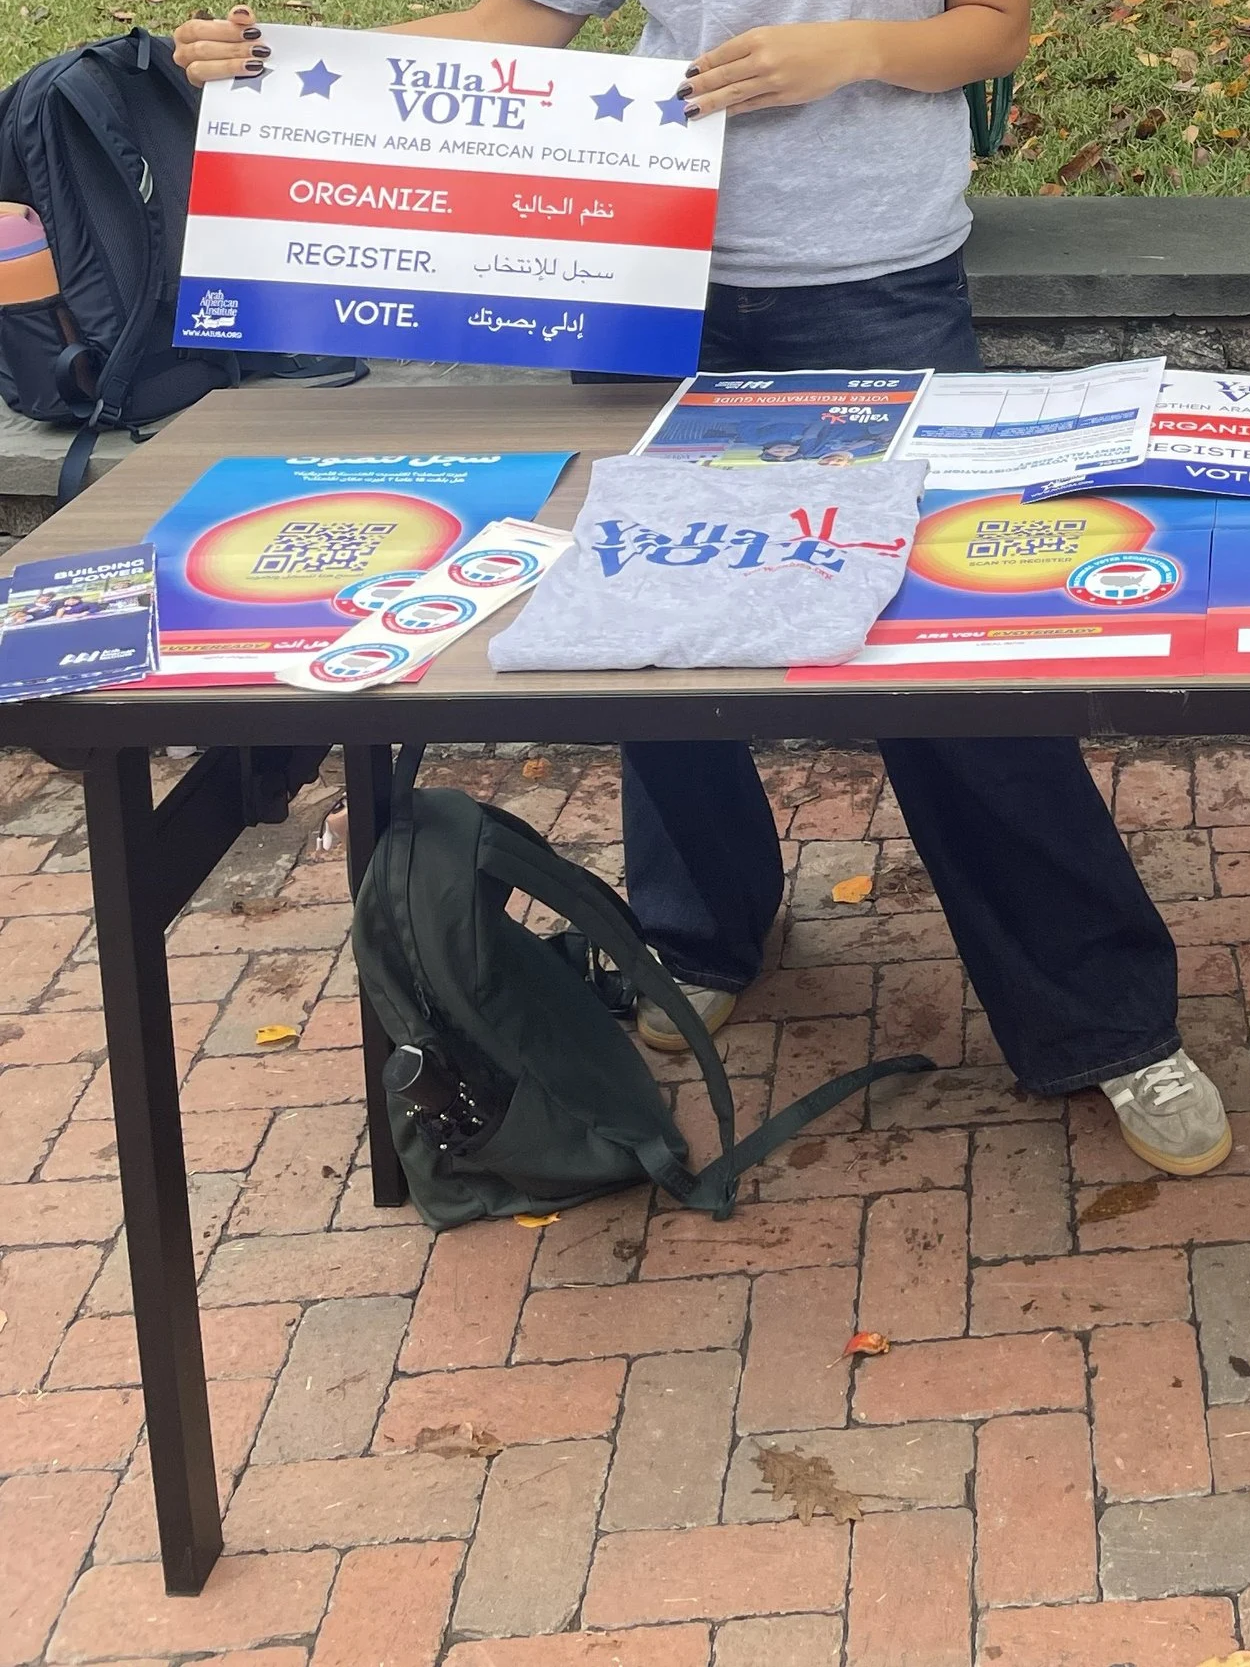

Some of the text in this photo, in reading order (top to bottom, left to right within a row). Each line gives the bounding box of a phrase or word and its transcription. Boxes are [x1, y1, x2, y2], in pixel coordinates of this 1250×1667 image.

[386, 57, 485, 93] Yalla
[389, 88, 527, 130] VOTE
[207, 121, 712, 173] HELP STRENGTHEN ARAB AMERICAN POLITICAL POWER
[289, 180, 453, 215] ORGANIZE.
[511, 193, 615, 226] نظم الجالية
[286, 241, 436, 274] REGISTER.
[562, 260, 615, 284] سجل
[200, 297, 239, 308] American
[205, 289, 225, 300] Arab
[205, 307, 238, 317] Institute
[334, 298, 419, 329] VOTE.
[467, 306, 537, 335] بصوتك
[847, 379, 900, 388] 2025
[712, 394, 890, 405] VOTER REGISTRATION GUIDE
[53, 558, 145, 580] BUILDING
[72, 567, 145, 584] POWER
[916, 630, 949, 640] ARE
[951, 630, 986, 638] YOU
